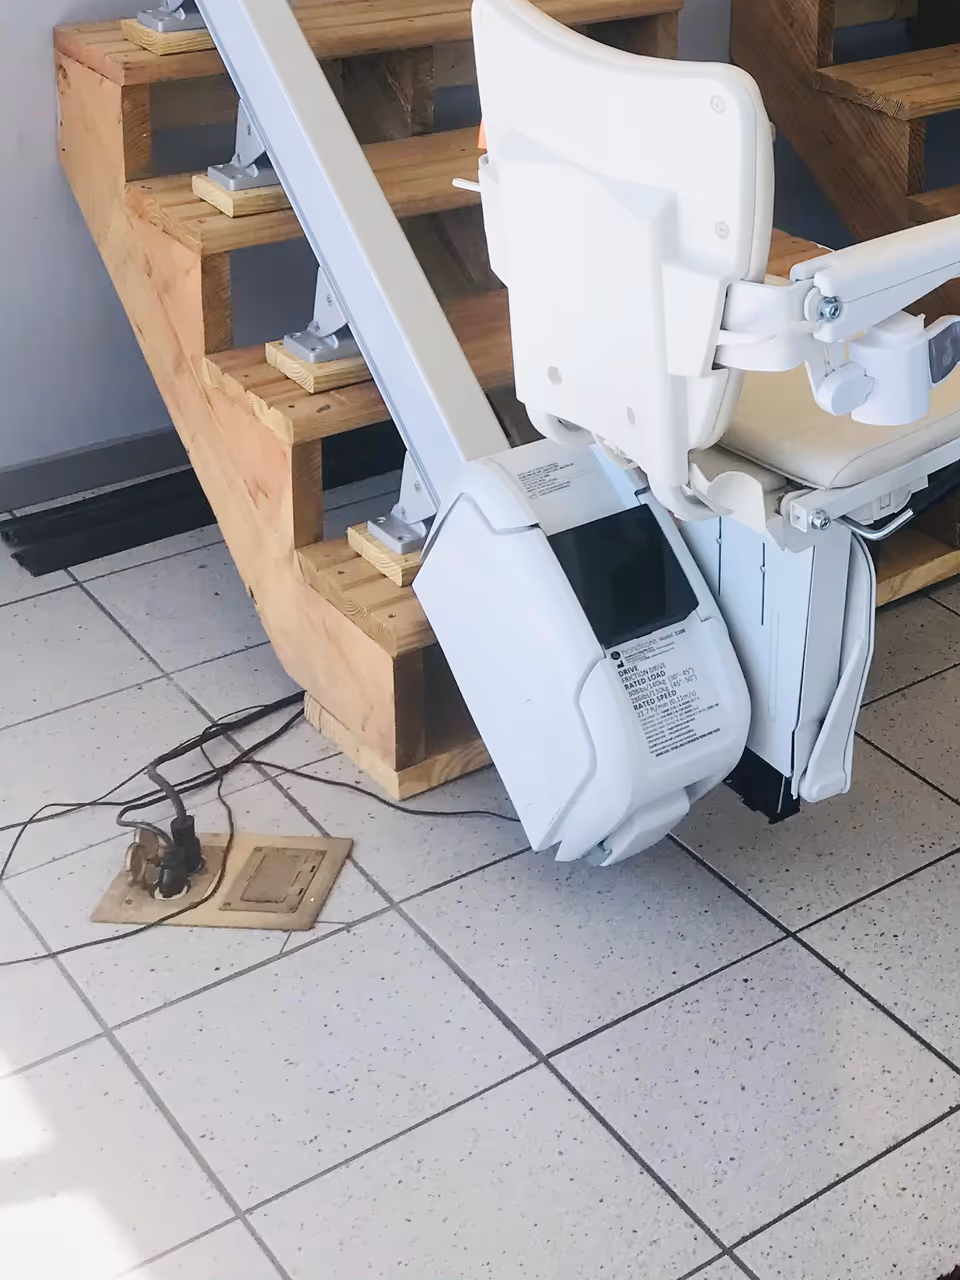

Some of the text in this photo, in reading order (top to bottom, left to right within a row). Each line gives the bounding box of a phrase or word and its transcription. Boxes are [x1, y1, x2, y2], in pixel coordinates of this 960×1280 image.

[618, 665, 639, 677] DRIVE
[621, 662, 667, 683] FRICTION DRIVE
[624, 670, 666, 690] RATED LOAD
[633, 690, 677, 711] RATED SPEED
[650, 702, 669, 713] ft/min
